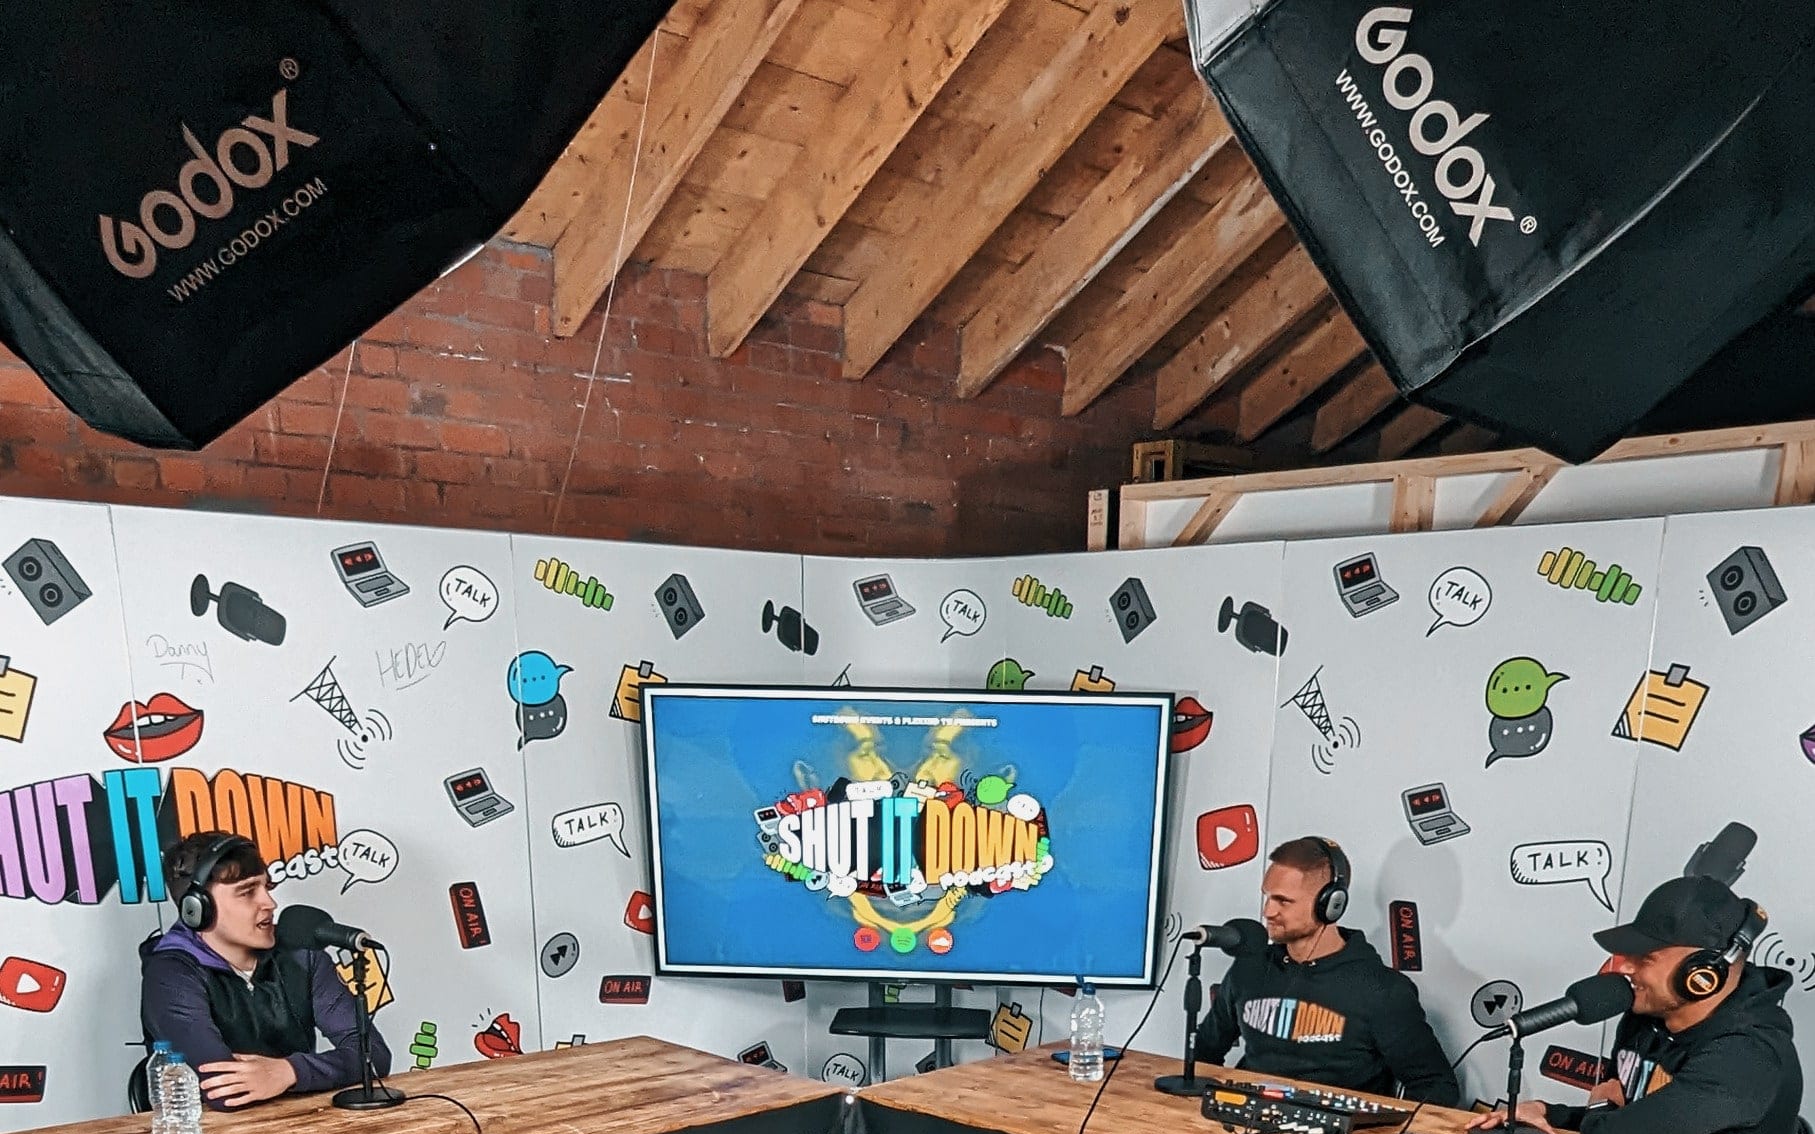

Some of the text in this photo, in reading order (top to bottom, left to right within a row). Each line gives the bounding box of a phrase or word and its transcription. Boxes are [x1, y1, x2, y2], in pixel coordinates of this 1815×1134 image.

[1335, 69, 1446, 248] WWW.GODOX.COM
[166, 177, 328, 302] WWW.GODOX.COM
[455, 577, 491, 608] TALK
[953, 599, 980, 623] TALK
[1447, 580, 1483, 610] TALK
[103, 768, 168, 904] IT
[171, 766, 340, 868] DOWN
[778, 797, 1039, 885] SHUT IT DOWN
[352, 842, 391, 868] TALK
[459, 887, 482, 937] ON AIR
[1400, 907, 1416, 960] ON AIR
[604, 980, 642, 994] ON AIR
[1243, 998, 1346, 1041] SHUT IT DOWN
[832, 1062, 860, 1082] TALK
[1548, 1052, 1606, 1079] ON AIR
